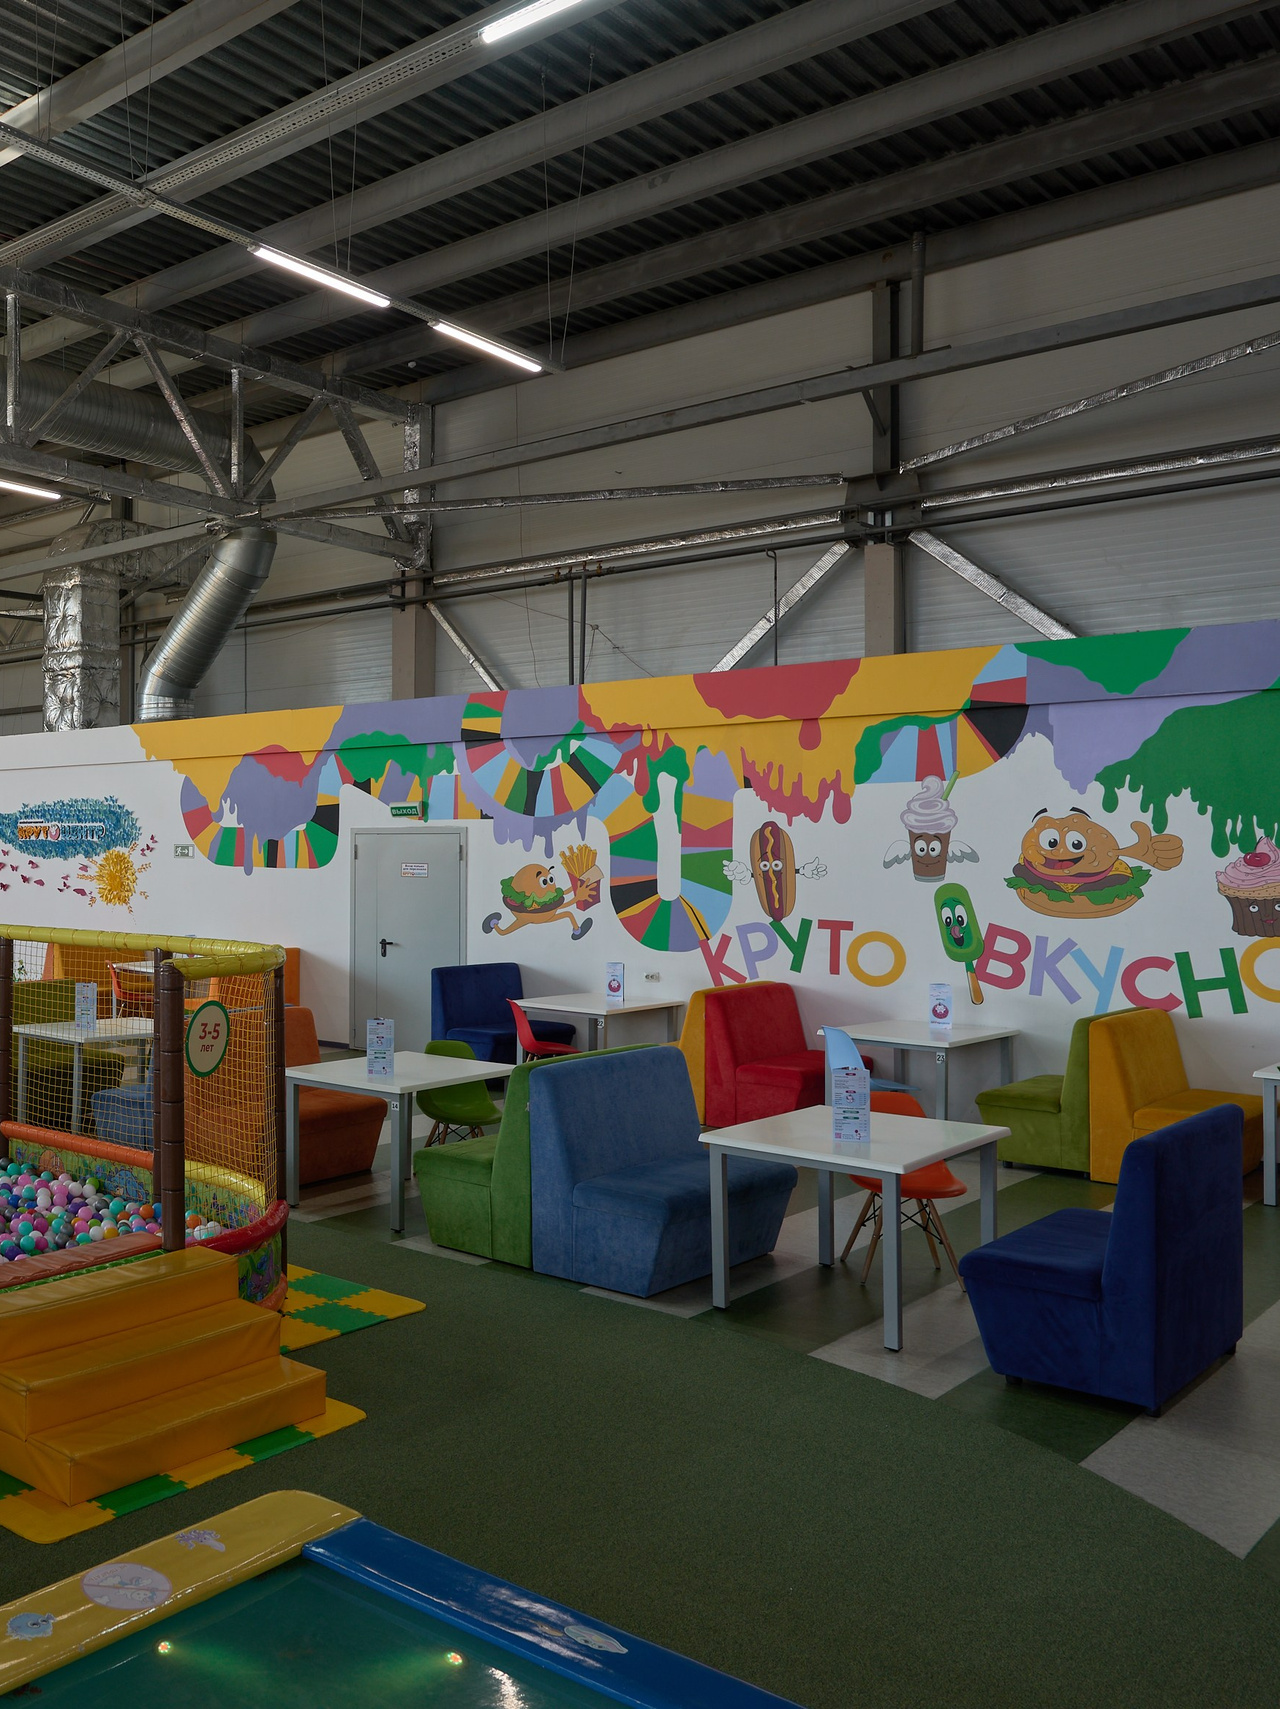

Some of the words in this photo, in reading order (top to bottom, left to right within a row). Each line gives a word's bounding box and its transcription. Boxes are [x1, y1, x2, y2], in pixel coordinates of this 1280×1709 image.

[698, 917, 907, 988] КРУТО
[975, 922, 1280, 1019] ВКУСНО
[199, 1022, 221, 1040] 3-5
[200, 1044, 214, 1052] лет
[936, 1054, 945, 1062] 23
